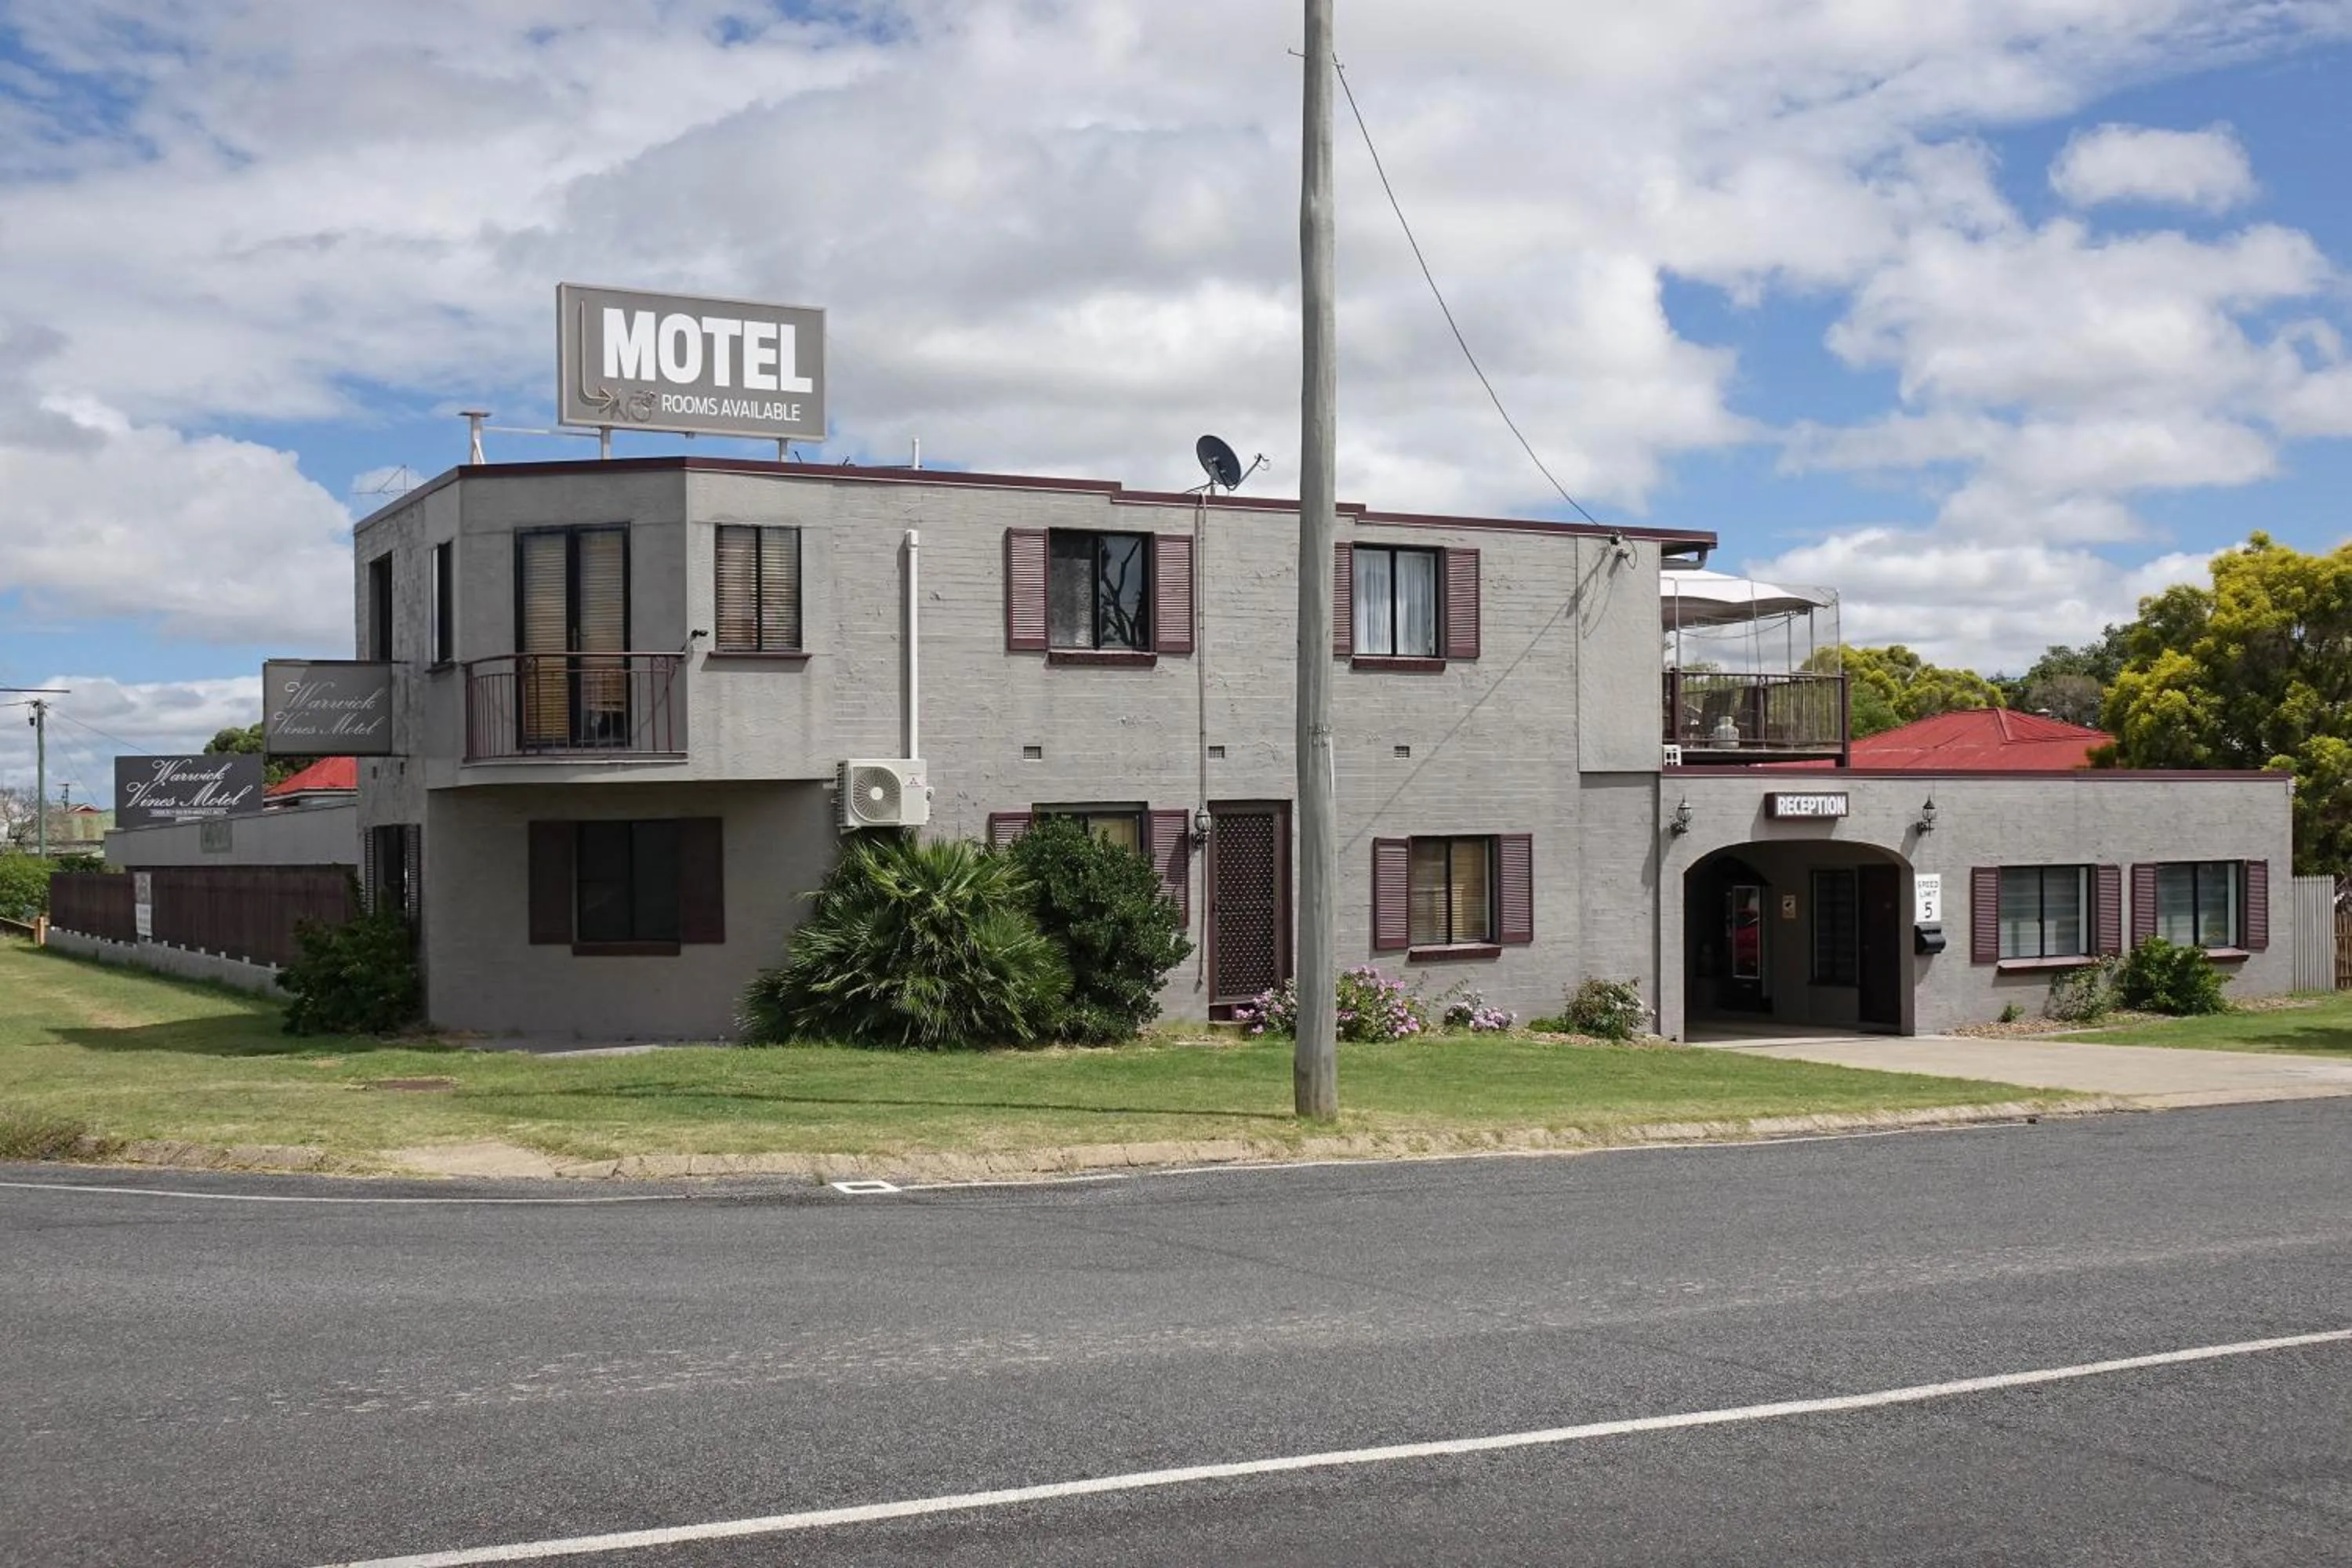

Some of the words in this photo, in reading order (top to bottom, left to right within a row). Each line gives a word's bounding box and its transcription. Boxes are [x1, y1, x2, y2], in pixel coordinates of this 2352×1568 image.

[603, 307, 813, 394] MOTEL
[662, 394, 717, 416] ROOMS
[720, 399, 800, 422] AVAILABLE
[285, 681, 384, 709] Warwick
[274, 711, 317, 735] Vines
[319, 713, 386, 735] Motel
[151, 759, 233, 786] Warwick
[126, 782, 176, 808] Vines
[179, 780, 253, 807] Motel
[1777, 795, 1846, 815] RECEPTION
[1925, 901, 1933, 919] 5
